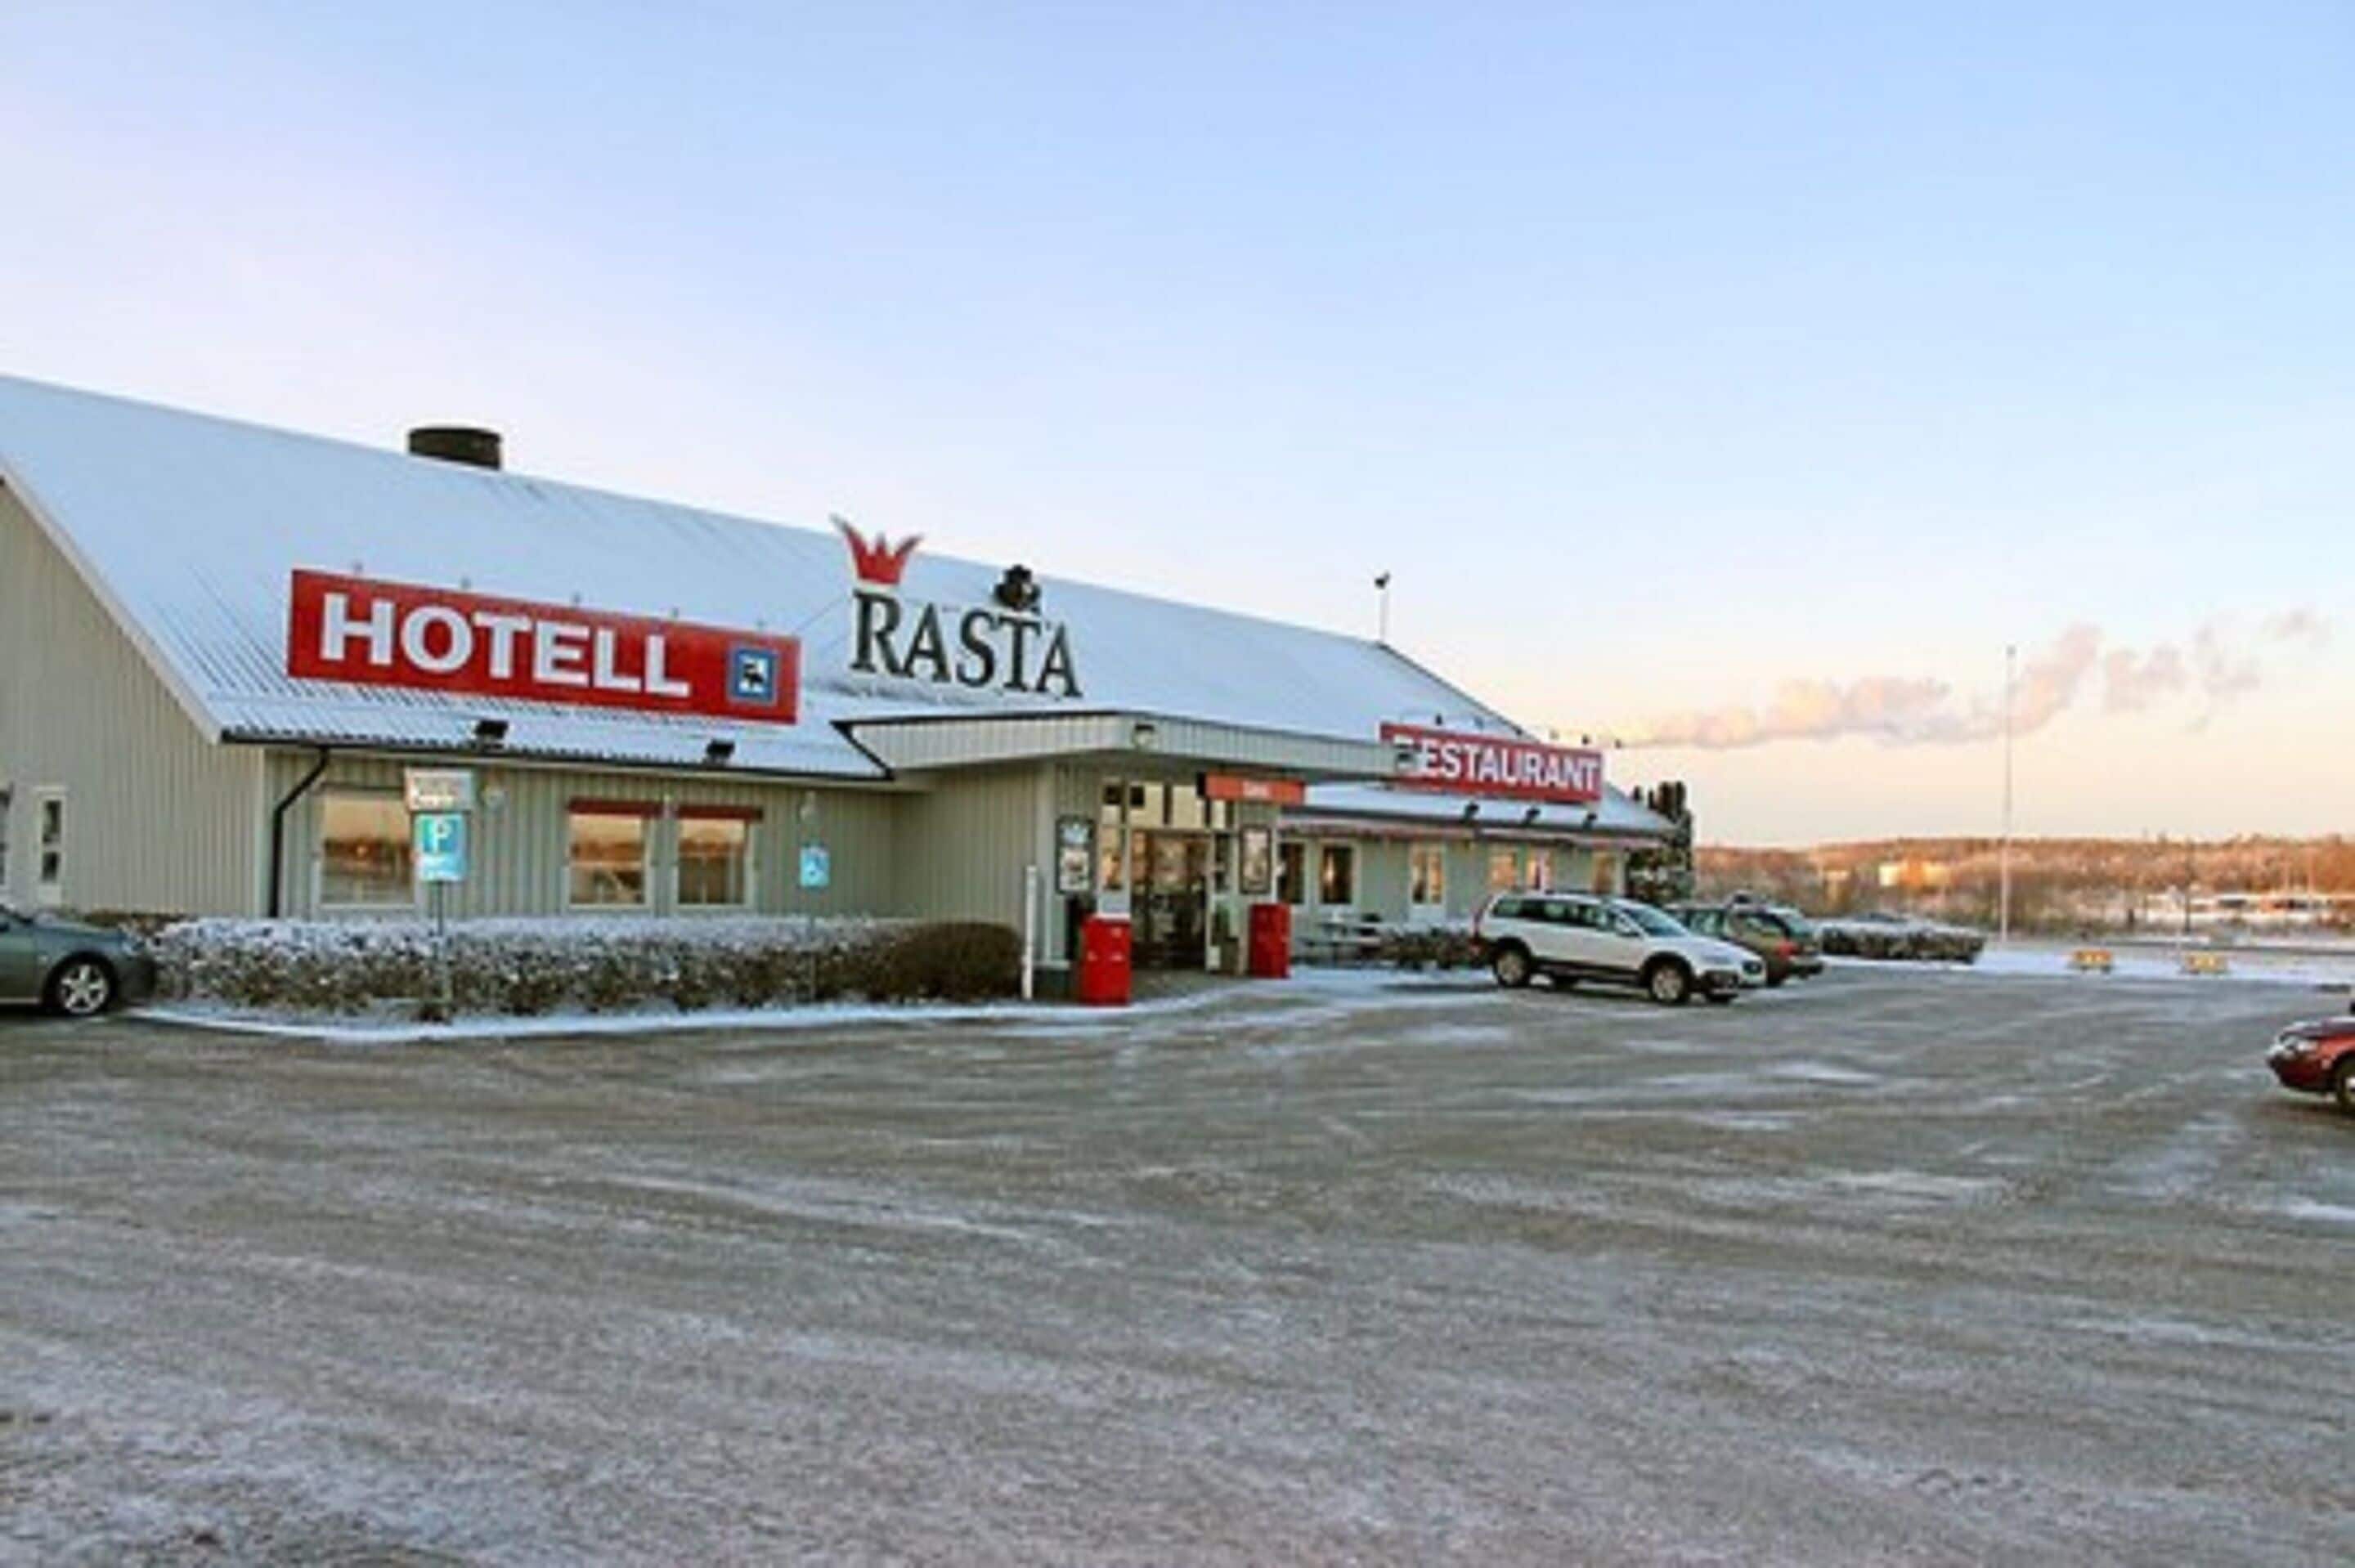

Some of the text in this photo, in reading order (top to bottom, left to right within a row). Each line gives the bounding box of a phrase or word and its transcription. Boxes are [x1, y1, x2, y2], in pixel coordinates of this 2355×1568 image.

[320, 592, 690, 697] HOTELL
[849, 587, 1083, 698] RASTA
[431, 817, 452, 854] P
